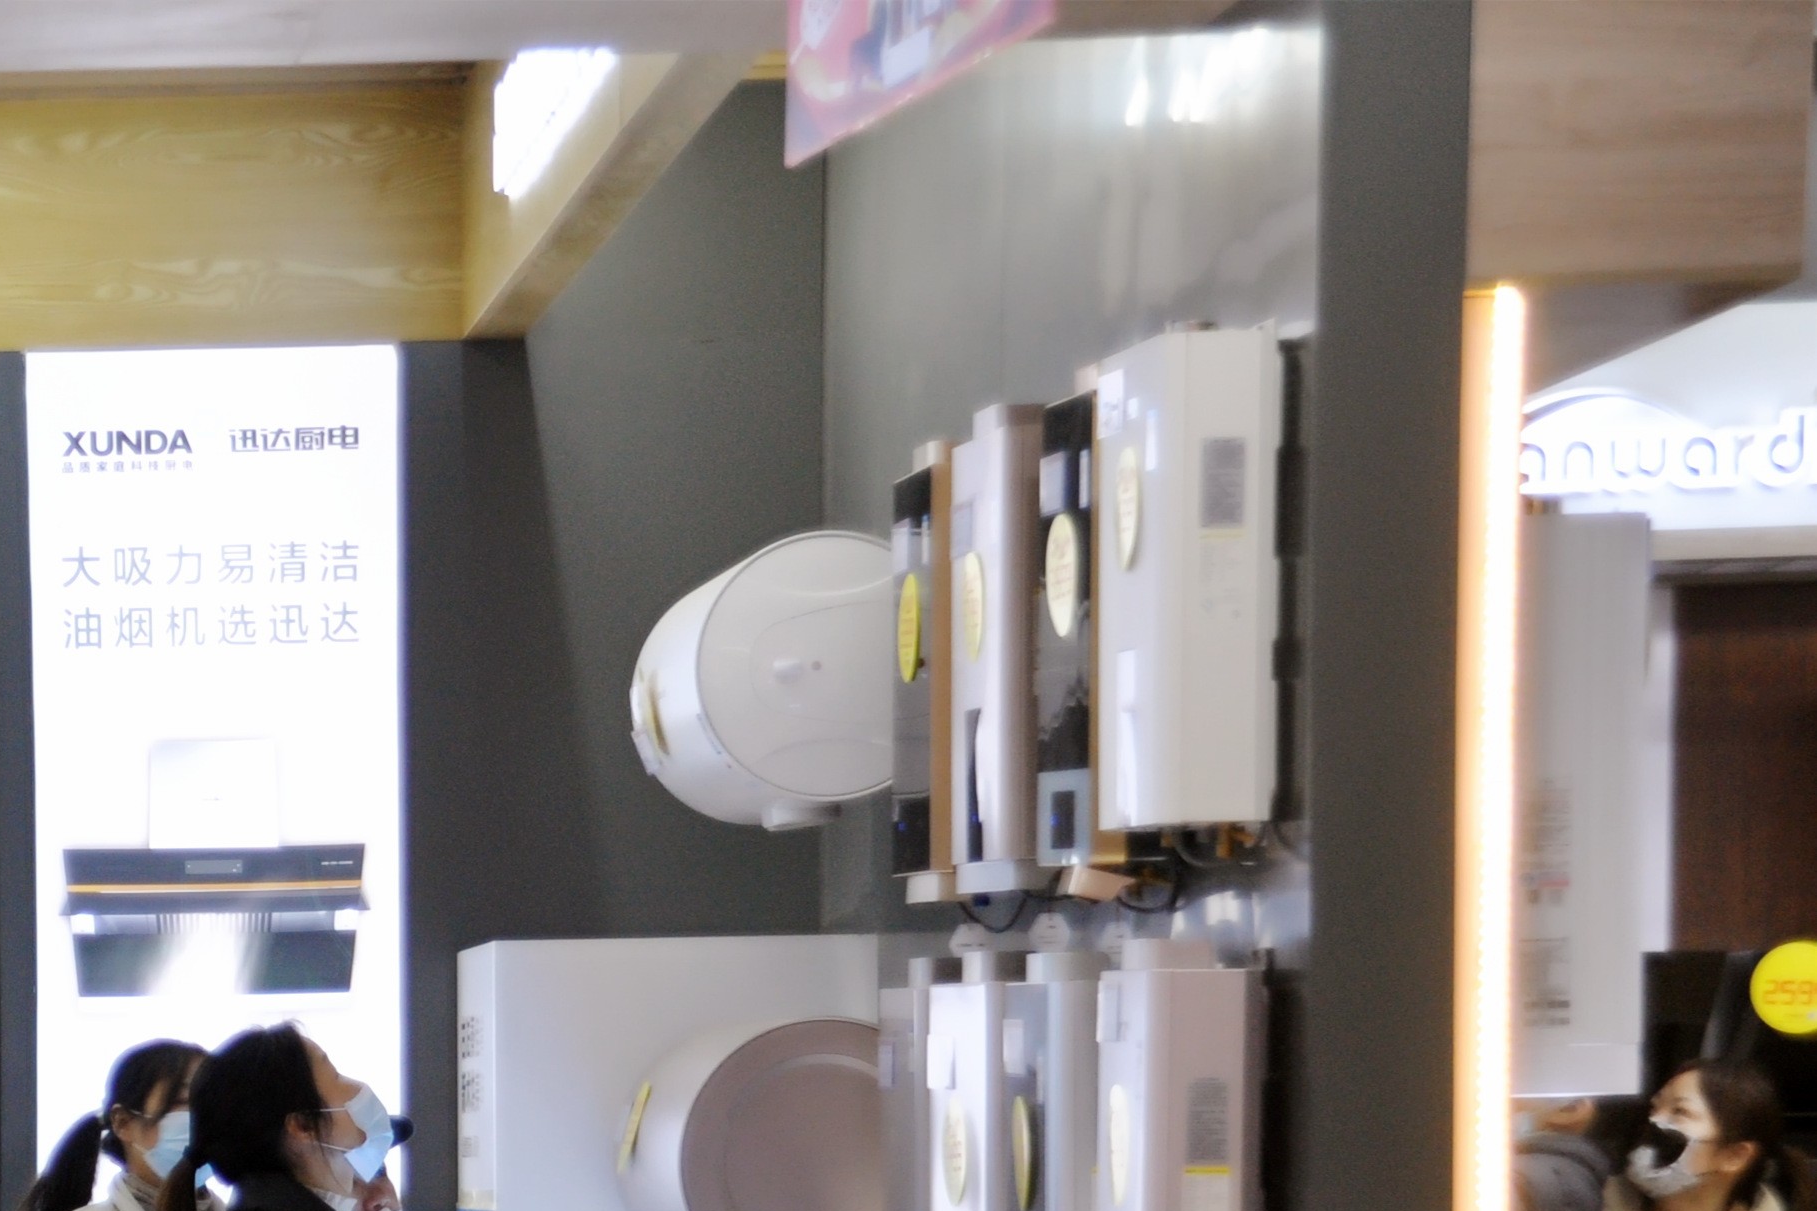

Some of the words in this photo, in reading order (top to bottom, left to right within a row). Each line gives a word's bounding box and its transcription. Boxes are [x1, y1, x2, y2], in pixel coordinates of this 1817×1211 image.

[62, 430, 193, 457] XUNDA
[229, 425, 360, 453] 迅达厨电
[61, 540, 360, 588] 大吸力易清洁
[63, 602, 360, 650] 油烟机选迅达
